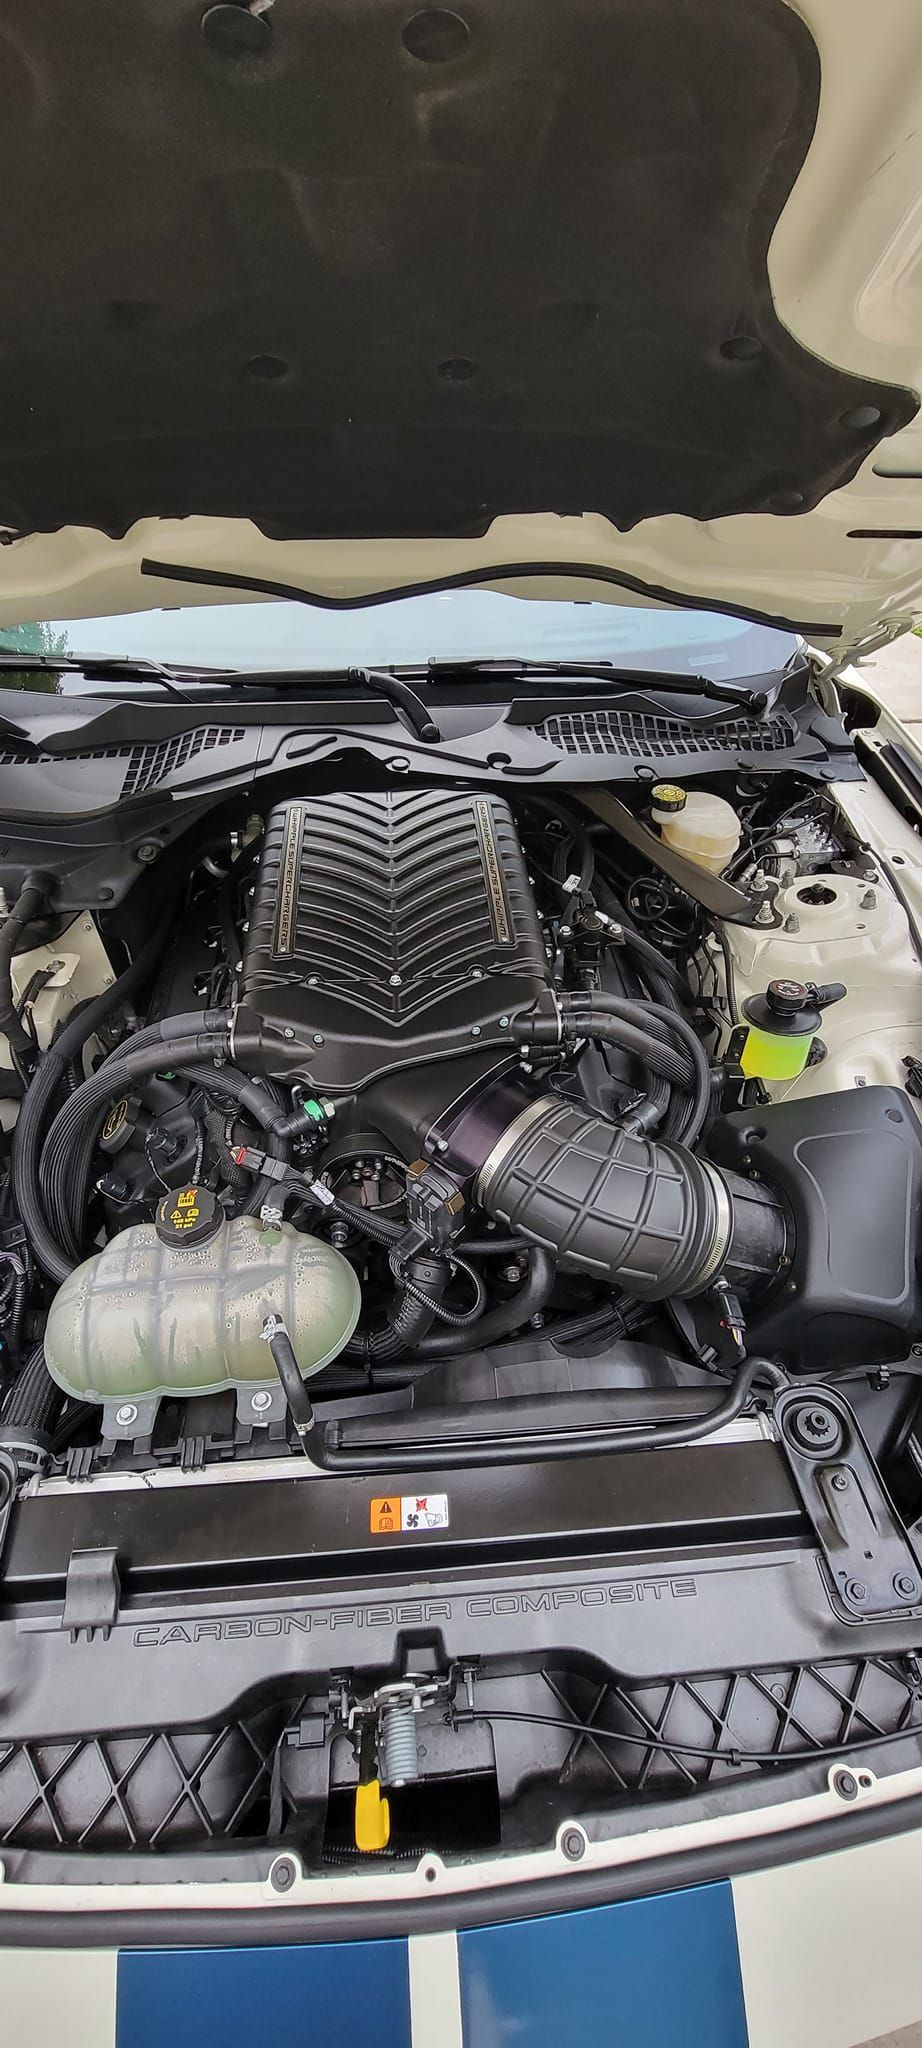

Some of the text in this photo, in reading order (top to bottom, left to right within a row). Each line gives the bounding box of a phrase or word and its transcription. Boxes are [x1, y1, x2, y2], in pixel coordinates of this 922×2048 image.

[281, 851, 295, 946] SUPERCHARGERS
[480, 806, 507, 936] WHIPPLE SUPERCHARGERS
[133, 1578, 697, 1647] CARBON-FIBER COMPOSITE
